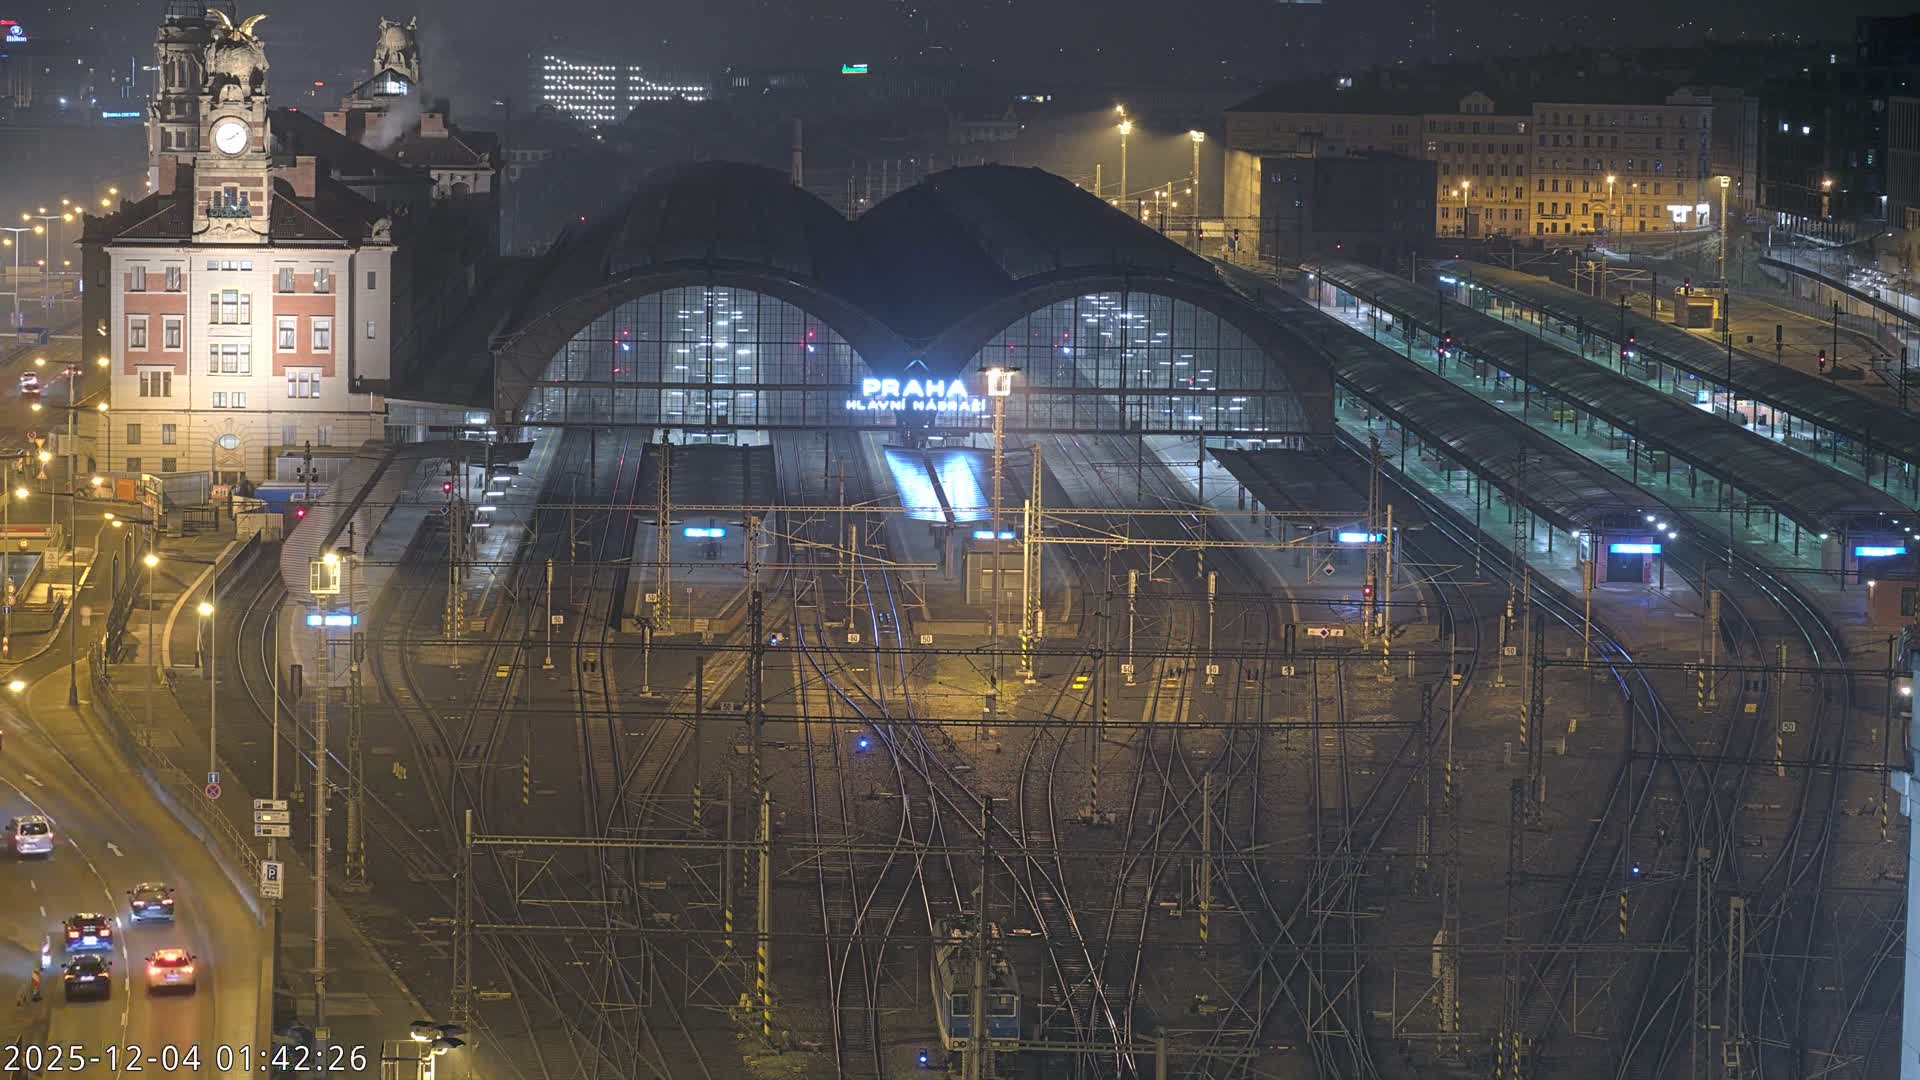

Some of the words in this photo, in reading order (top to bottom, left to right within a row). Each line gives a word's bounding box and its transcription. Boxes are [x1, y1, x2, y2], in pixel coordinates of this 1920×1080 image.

[863, 377, 968, 397] PRAHA
[846, 398, 906, 410] HLAVNÍ
[912, 398, 986, 411] NÁDRAŽÍ
